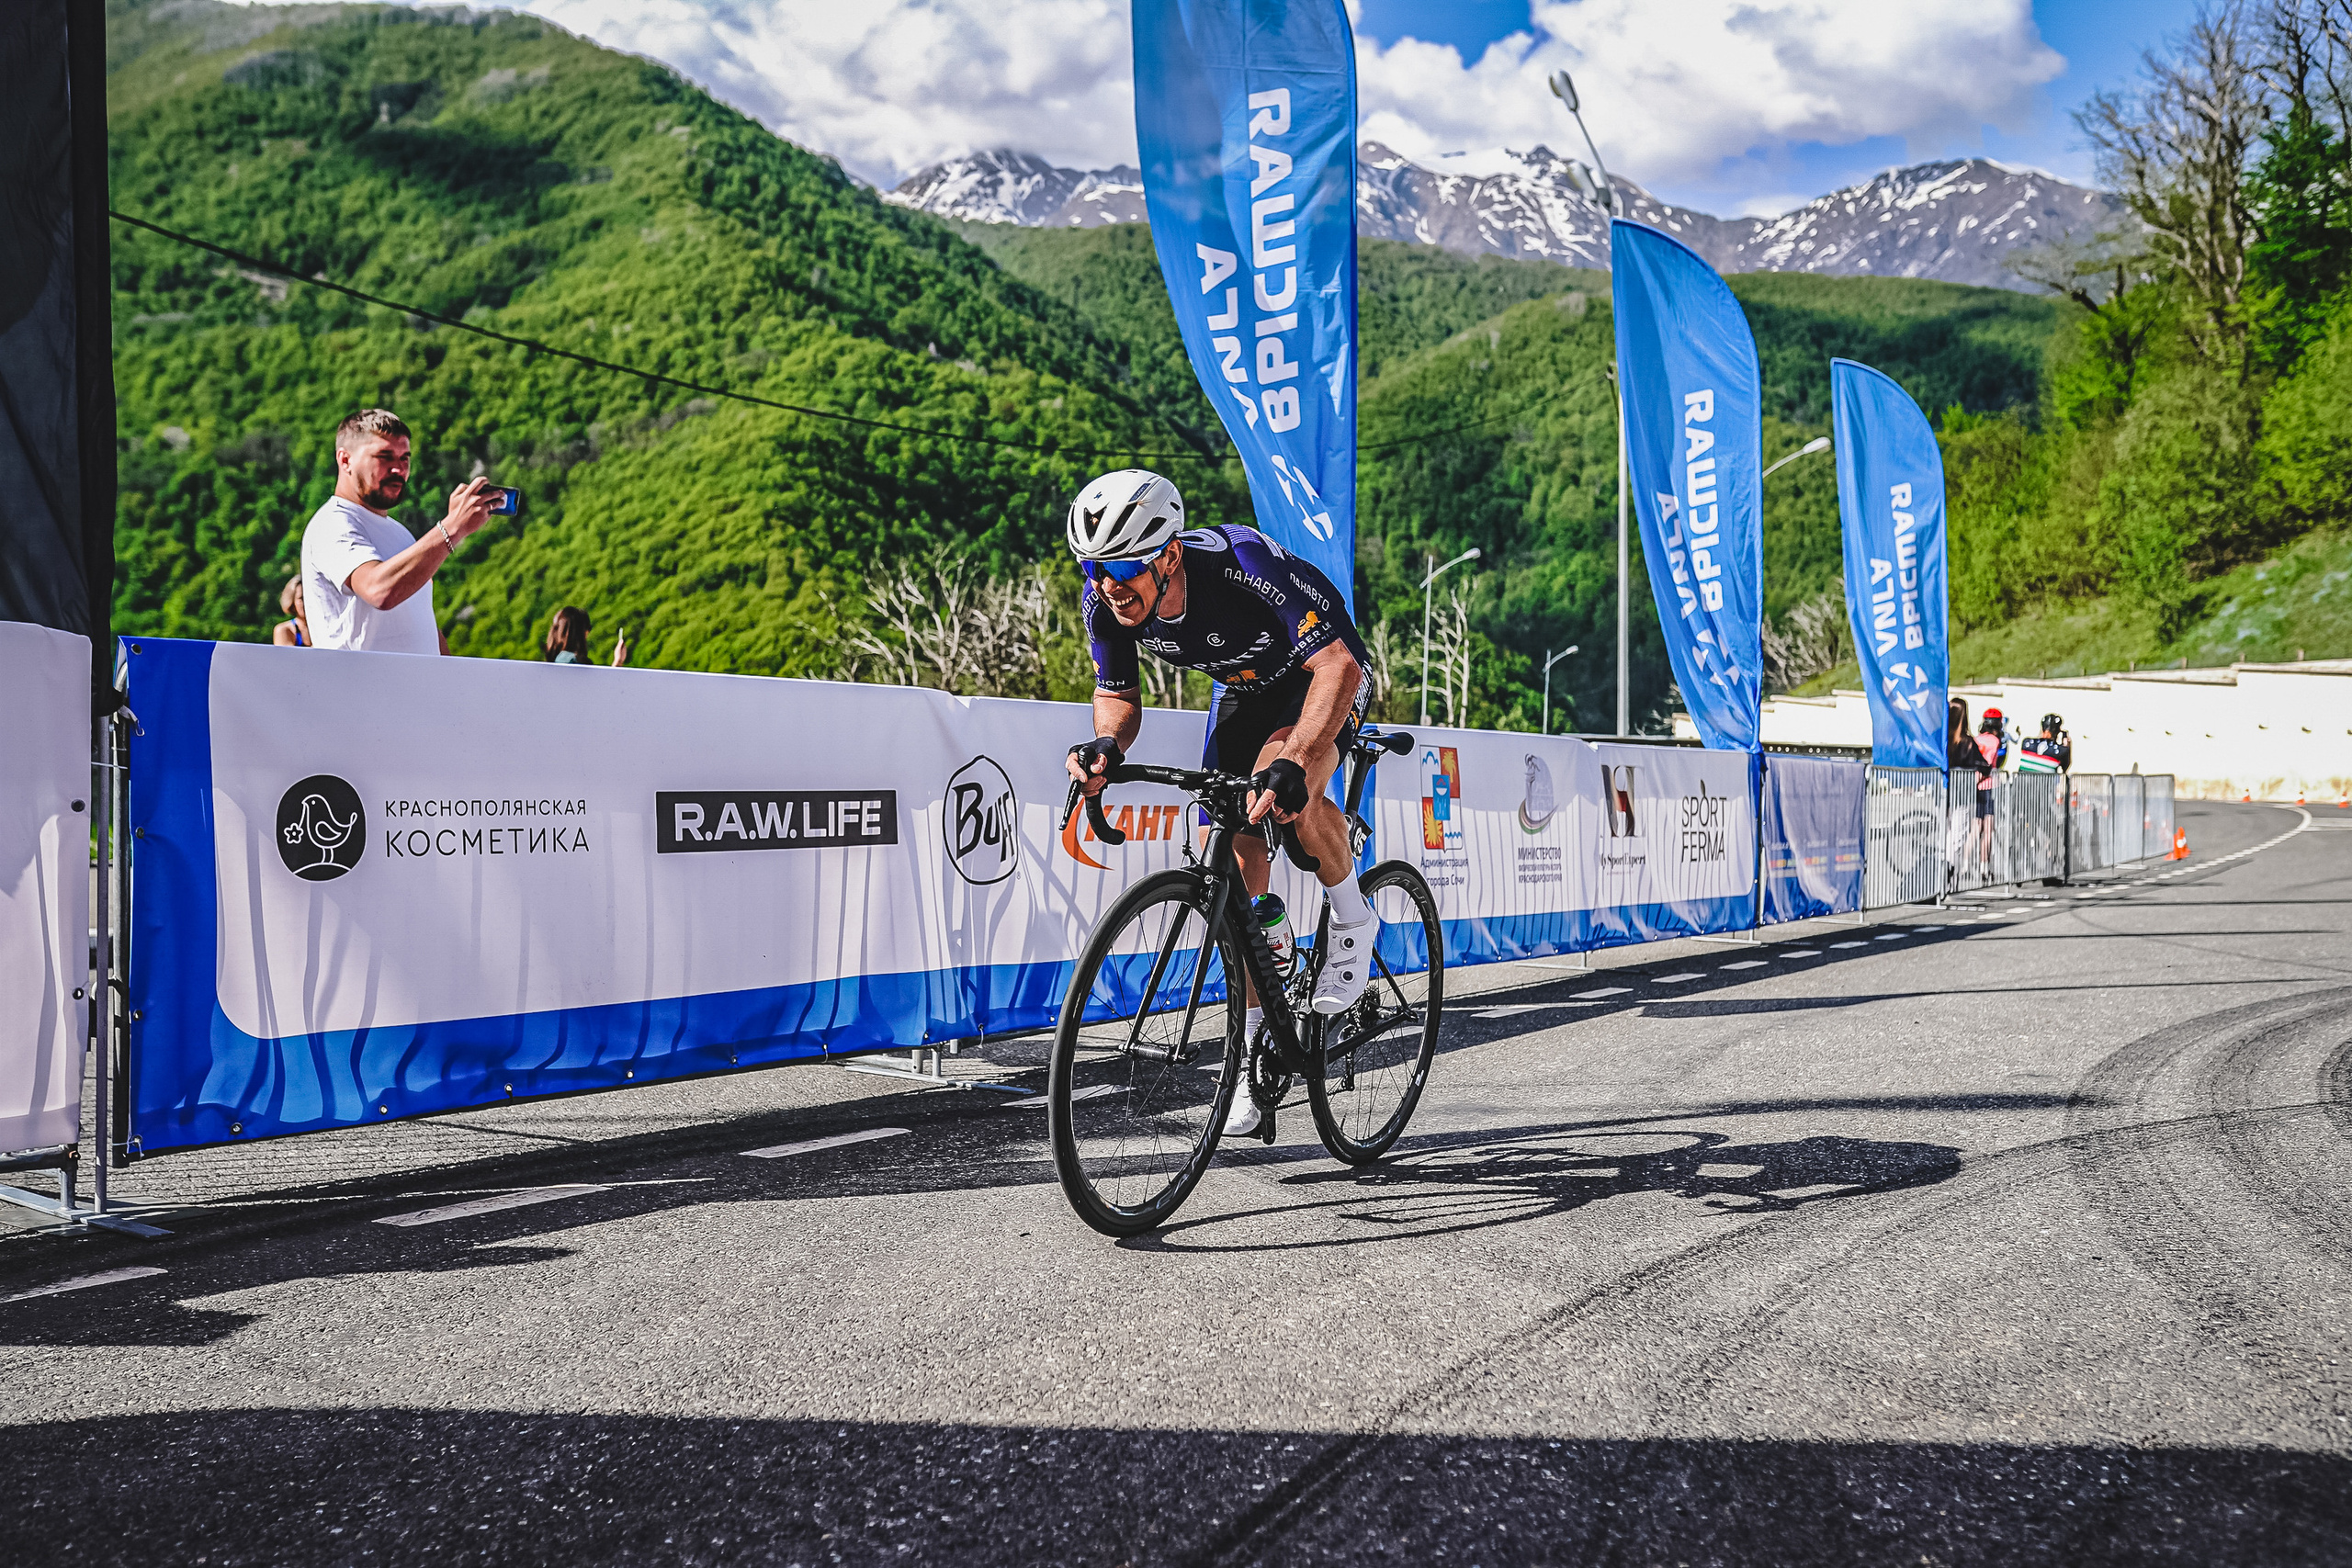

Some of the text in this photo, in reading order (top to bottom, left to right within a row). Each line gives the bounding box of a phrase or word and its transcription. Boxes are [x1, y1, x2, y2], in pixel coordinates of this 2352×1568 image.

[1225, 568, 1286, 606] ПАНАВТО
[1289, 572, 1329, 612] ПАНАВТО
[385, 799, 587, 818] КРАСНОПОЛЯНСКАЯ
[1681, 795, 1727, 828] SPORT
[386, 827, 590, 857] КОСМЕТИКА
[1517, 847, 1561, 860] МИНИСТЕРСТВО
[1681, 830, 1725, 863] FERMA
[1419, 856, 1468, 869] Администрация
[1426, 874, 1464, 888] города Сочи
